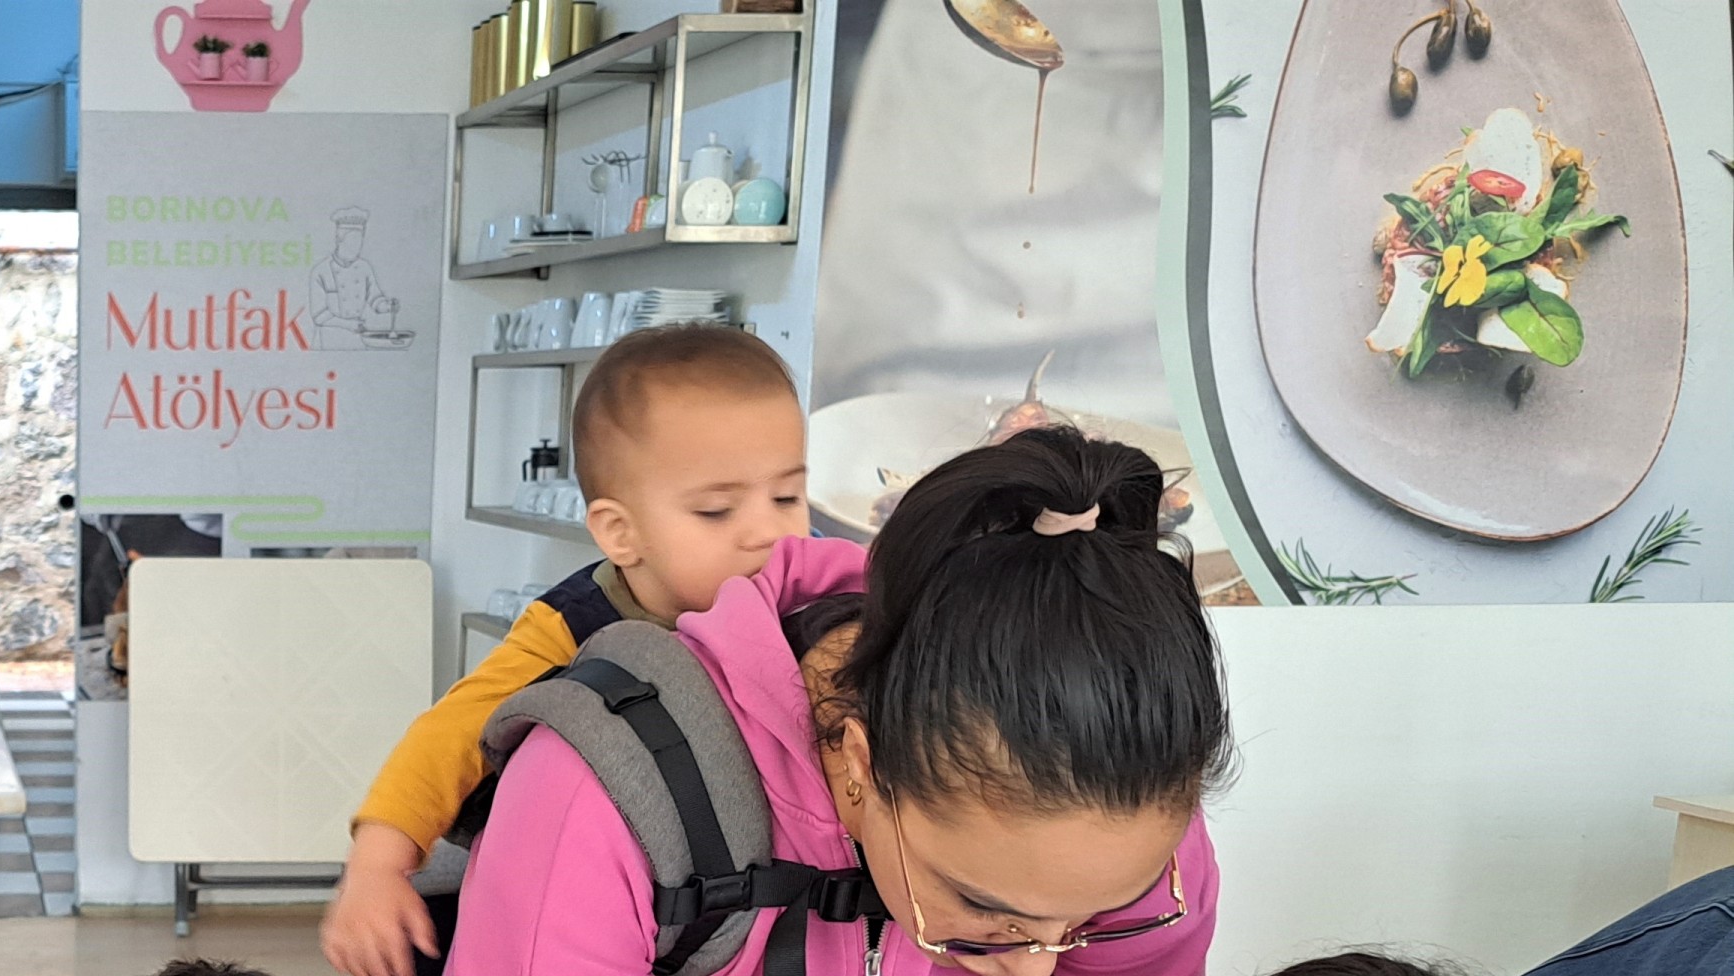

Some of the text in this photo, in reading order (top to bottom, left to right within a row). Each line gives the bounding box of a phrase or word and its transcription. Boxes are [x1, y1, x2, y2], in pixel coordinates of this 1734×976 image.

[106, 195, 289, 223] BORNOVA
[106, 233, 314, 267] BELEDİYESİ
[106, 288, 311, 351] Mutfak
[103, 369, 337, 449] Atölyesi
